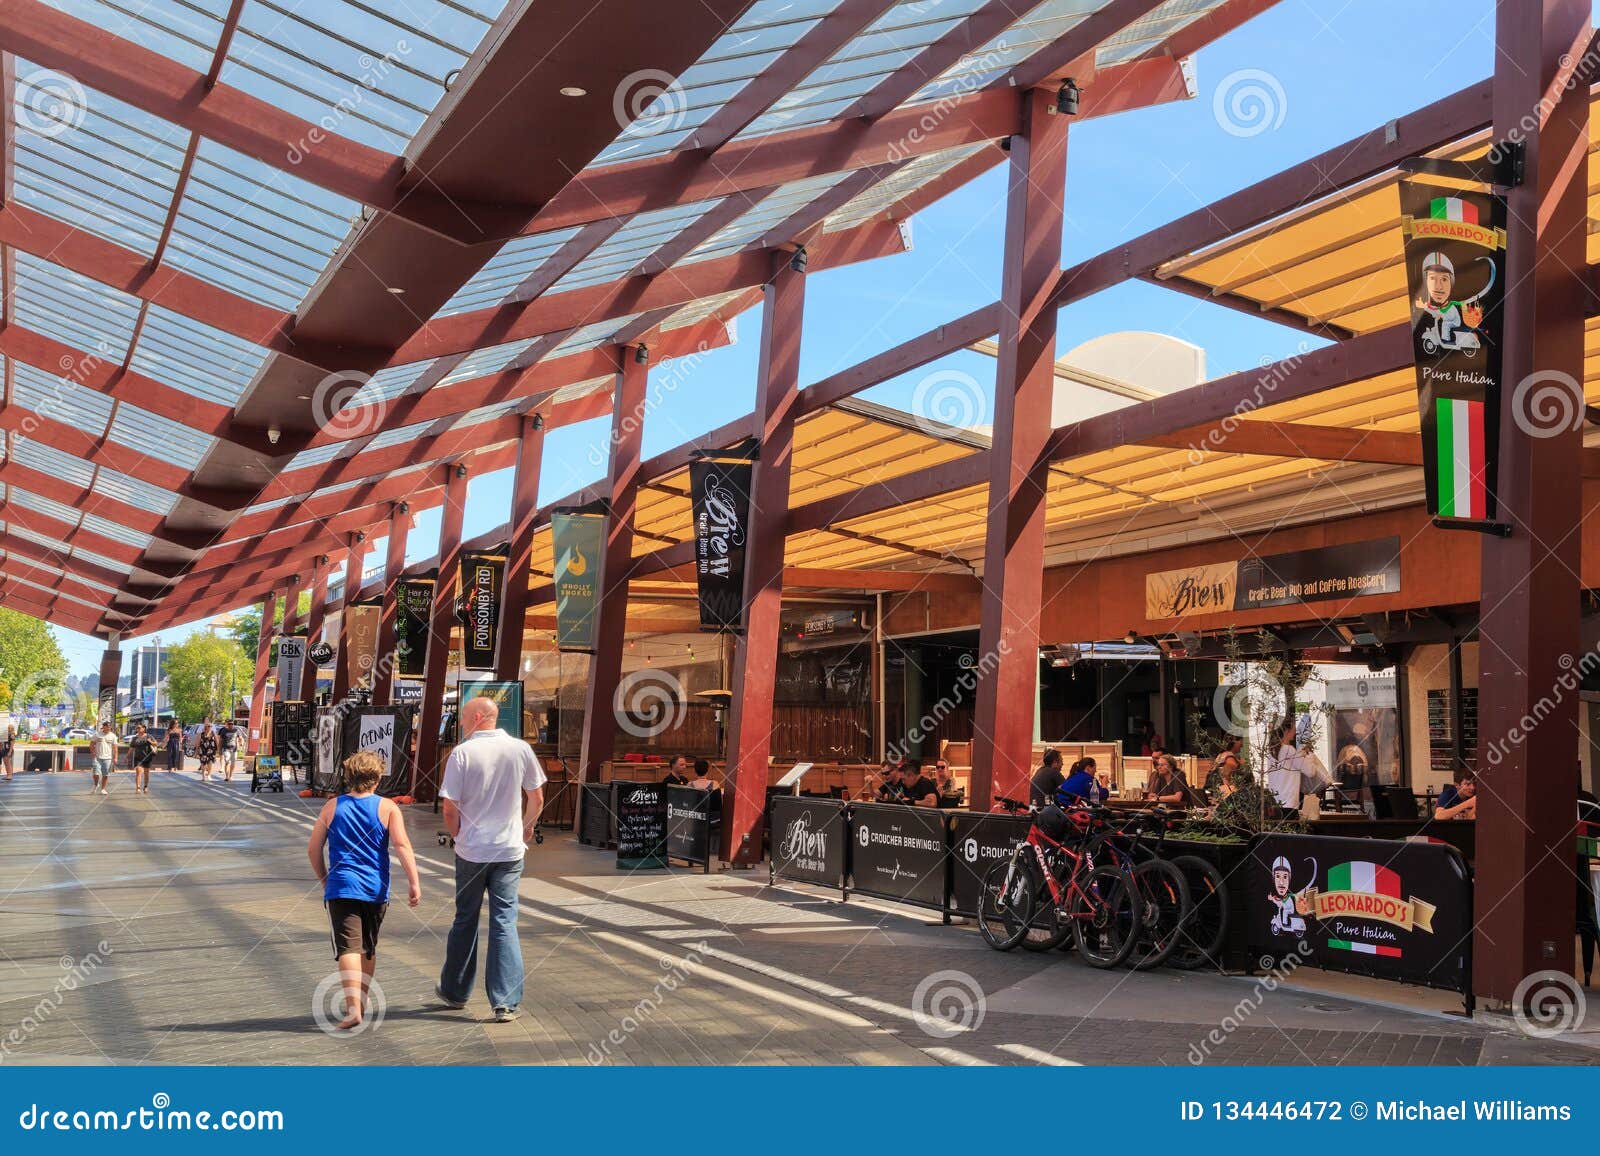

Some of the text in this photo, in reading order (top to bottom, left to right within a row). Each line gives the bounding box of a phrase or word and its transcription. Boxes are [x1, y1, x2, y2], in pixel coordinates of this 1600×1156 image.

[1415, 223, 1493, 245] LEONARDO'S
[1422, 367, 1495, 386] Pure Italian
[704, 473, 745, 579] Brew
[699, 512, 708, 574] Craft Beer Pub
[1158, 567, 1227, 617] Brew
[1249, 572, 1386, 602] Craft Beer Pub and Coffee Roastery
[407, 597, 431, 606] Beauty
[476, 569, 491, 648] PONSONBY RD
[281, 643, 301, 655] CBK
[310, 647, 331, 658] MOA
[361, 722, 393, 748] OPENING
[622, 785, 658, 803] Brew
[780, 810, 828, 861] Brew
[870, 832, 902, 847] CROUCHER
[903, 836, 932, 851] BREWING
[1034, 844, 1051, 881] GIANT
[1320, 895, 1407, 922] LEONARDO'S
[1336, 922, 1397, 940] Pure Italian
